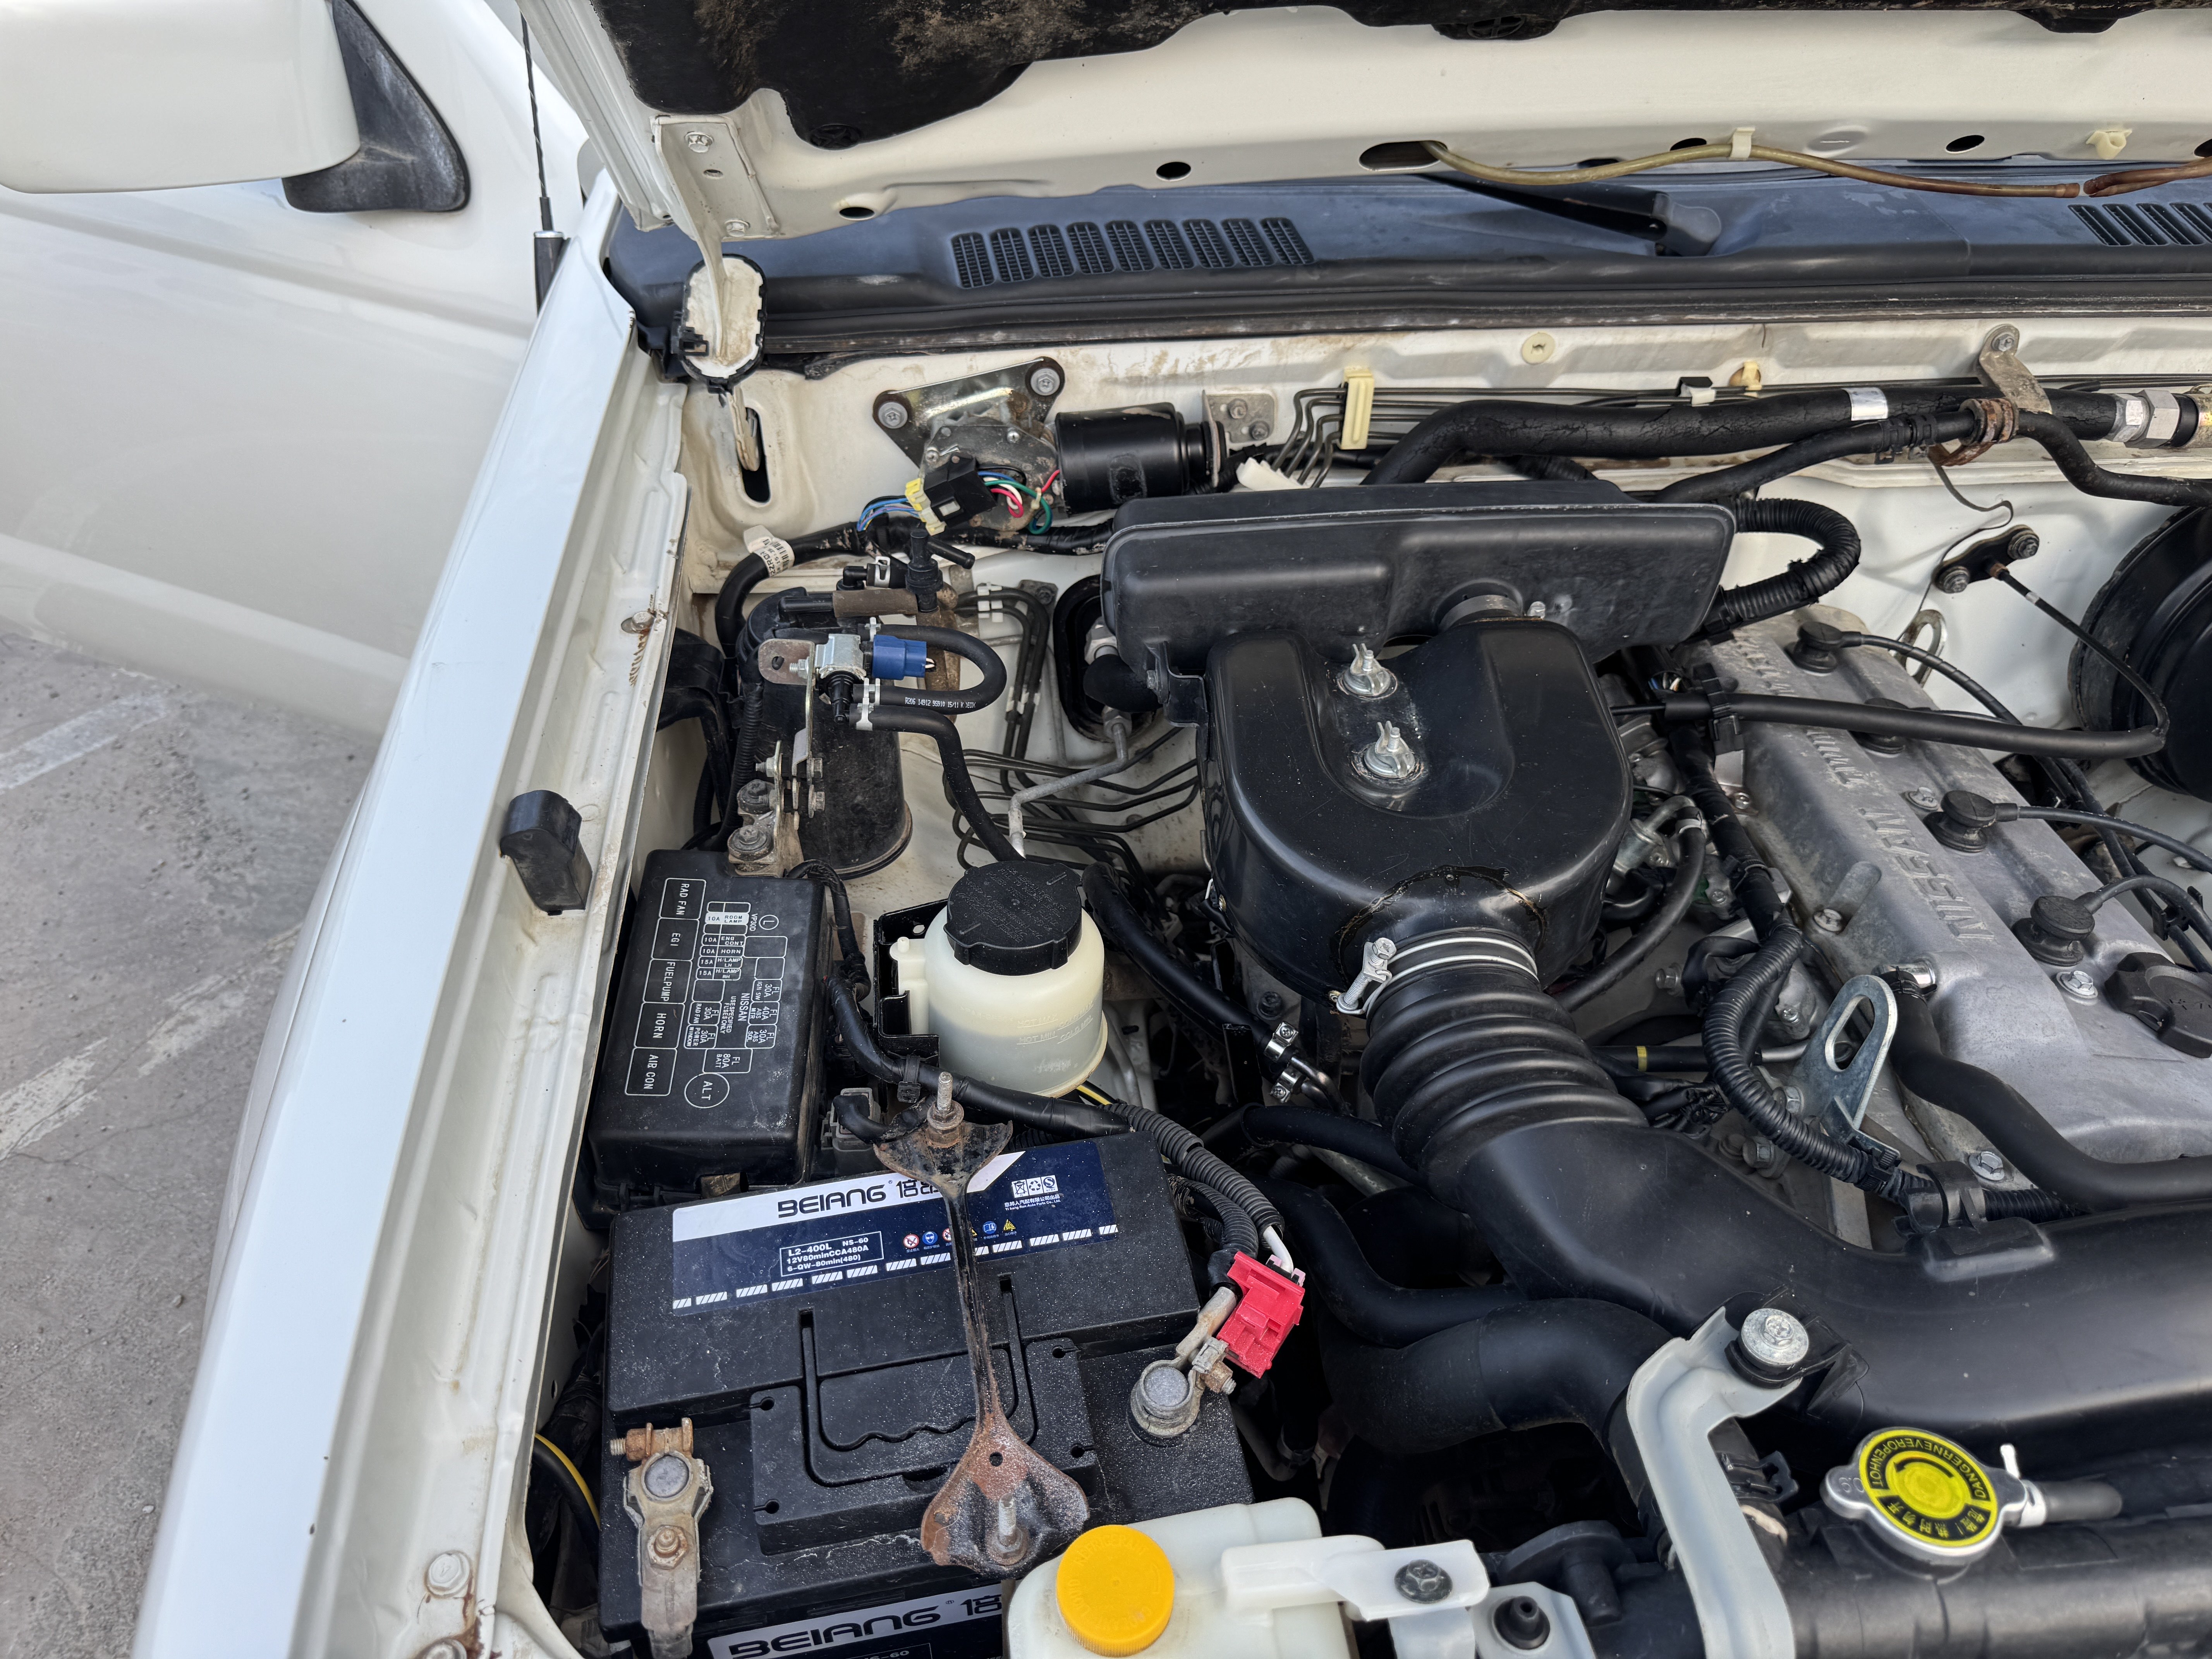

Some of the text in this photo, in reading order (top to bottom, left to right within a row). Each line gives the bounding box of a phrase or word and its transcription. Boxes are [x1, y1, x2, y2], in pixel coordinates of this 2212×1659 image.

[1860, 809, 1994, 940] NISSAN
[676, 883, 690, 915] RAD FAN
[750, 913, 758, 931] VP30D
[670, 933, 681, 947] EGI
[755, 992, 761, 1000] SW
[764, 984, 772, 998] 30A
[704, 1007, 712, 1020] 30A
[738, 993, 750, 1021] NISSAN
[761, 1006, 770, 1020] 40A
[769, 1009, 778, 1017] FL
[653, 1013, 666, 1039] HORN
[692, 1027, 701, 1046] POWER
[700, 1030, 708, 1044] 30A
[707, 1033, 716, 1041] FL
[758, 1029, 767, 1044] 30A
[1041, 1031, 1056, 1041] MIN
[721, 1054, 731, 1068] 80A
[732, 1056, 740, 1065] FL
[644, 1054, 659, 1089] AIR CON
[701, 1080, 713, 1100] ALT
[778, 1184, 886, 1218] BEIANG
[788, 1237, 869, 1257] L2-400L NS-60
[787, 1254, 861, 1272] 6-QW-80min(480)
[729, 1605, 941, 1659] BEIANG
